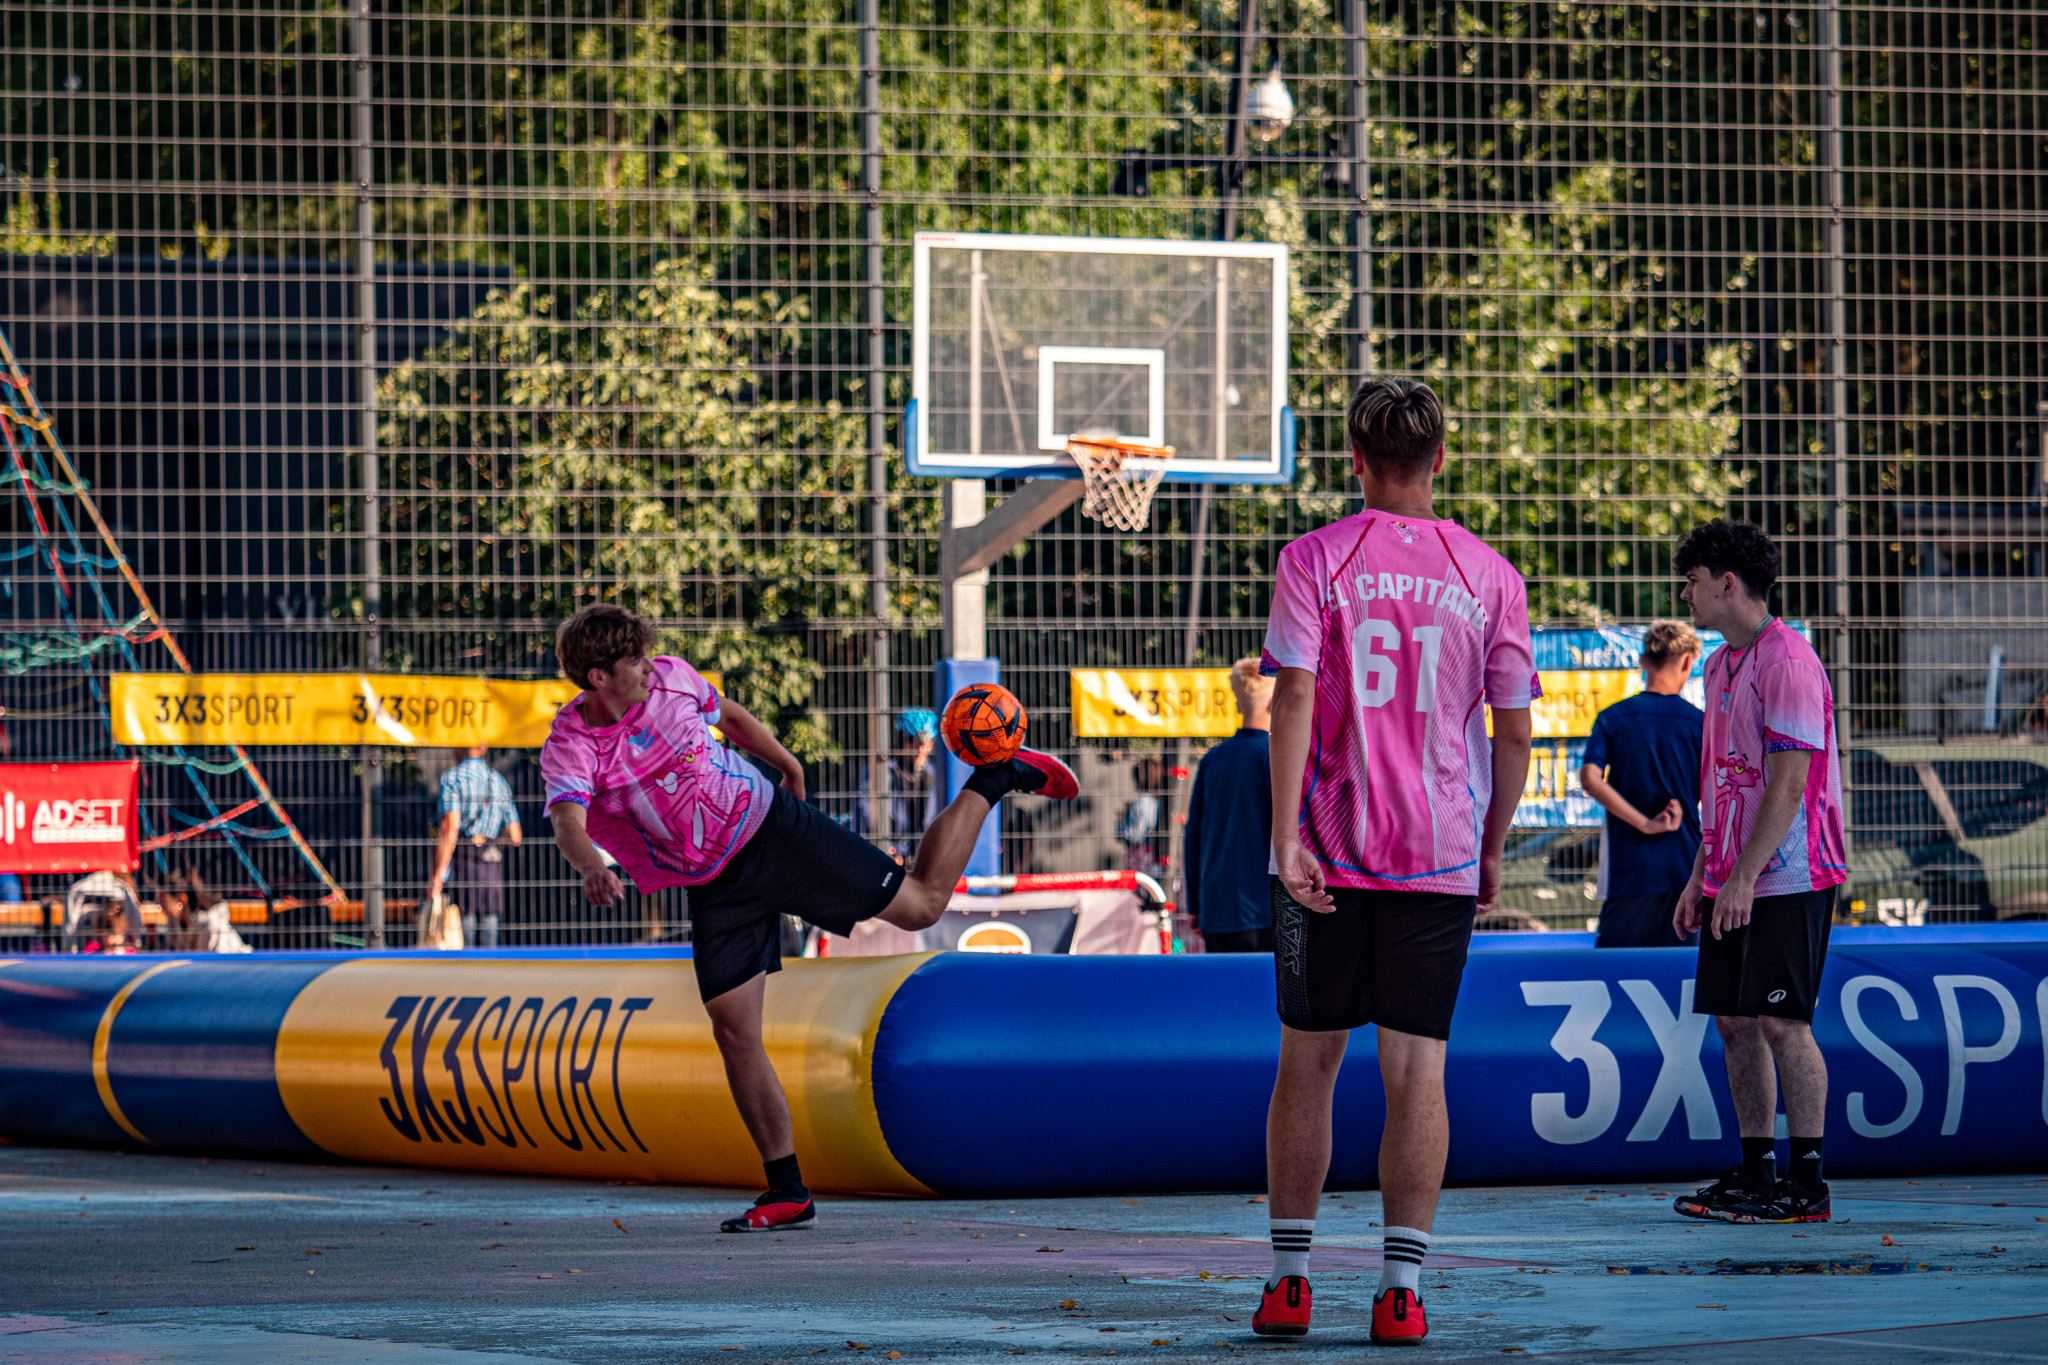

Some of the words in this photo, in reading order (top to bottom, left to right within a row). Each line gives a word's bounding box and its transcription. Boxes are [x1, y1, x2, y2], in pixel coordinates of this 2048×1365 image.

[1352, 618, 1443, 713] 61
[155, 693, 296, 727] 3X3SPORT
[1540, 688, 1602, 720] PORT
[32, 798, 124, 829] ADSET
[379, 996, 654, 1154] 3X3SPORT
[1519, 974, 2048, 1146] 3XSP
